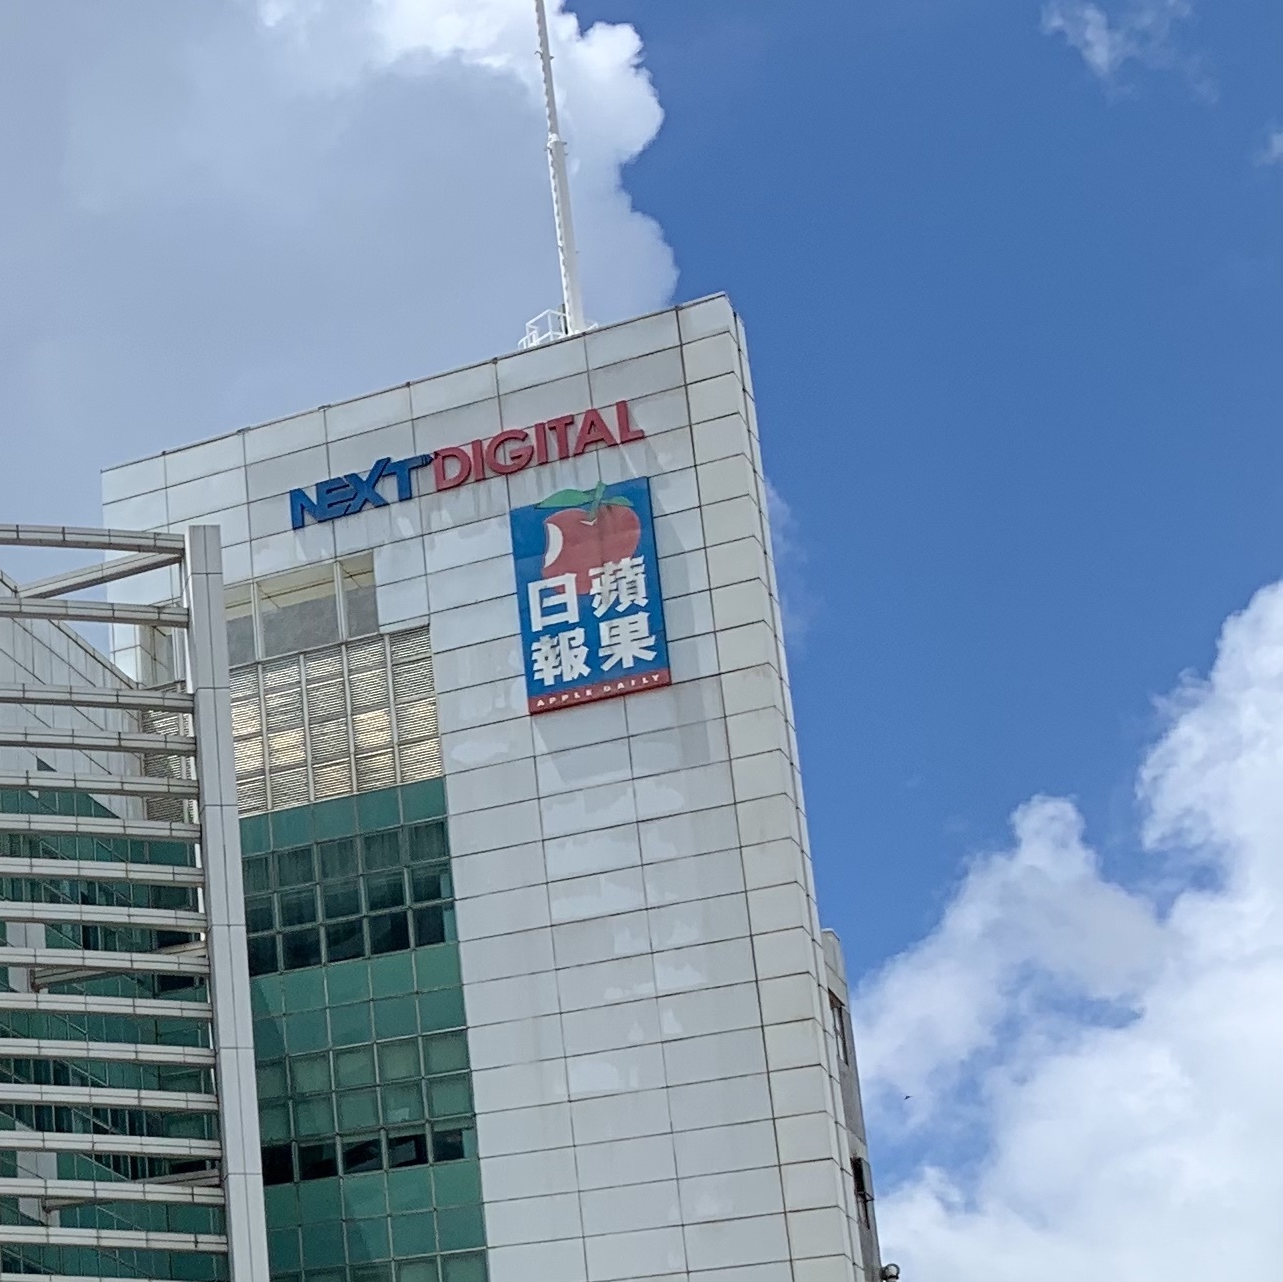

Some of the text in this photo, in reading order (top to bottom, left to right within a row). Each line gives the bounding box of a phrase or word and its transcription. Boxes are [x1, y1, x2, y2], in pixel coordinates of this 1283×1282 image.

[289, 400, 645, 530] NEXT DIGITAL
[527, 572, 592, 686] 日報
[588, 555, 657, 671] 蘋果
[536, 673, 661, 707] APPLE DAILY
